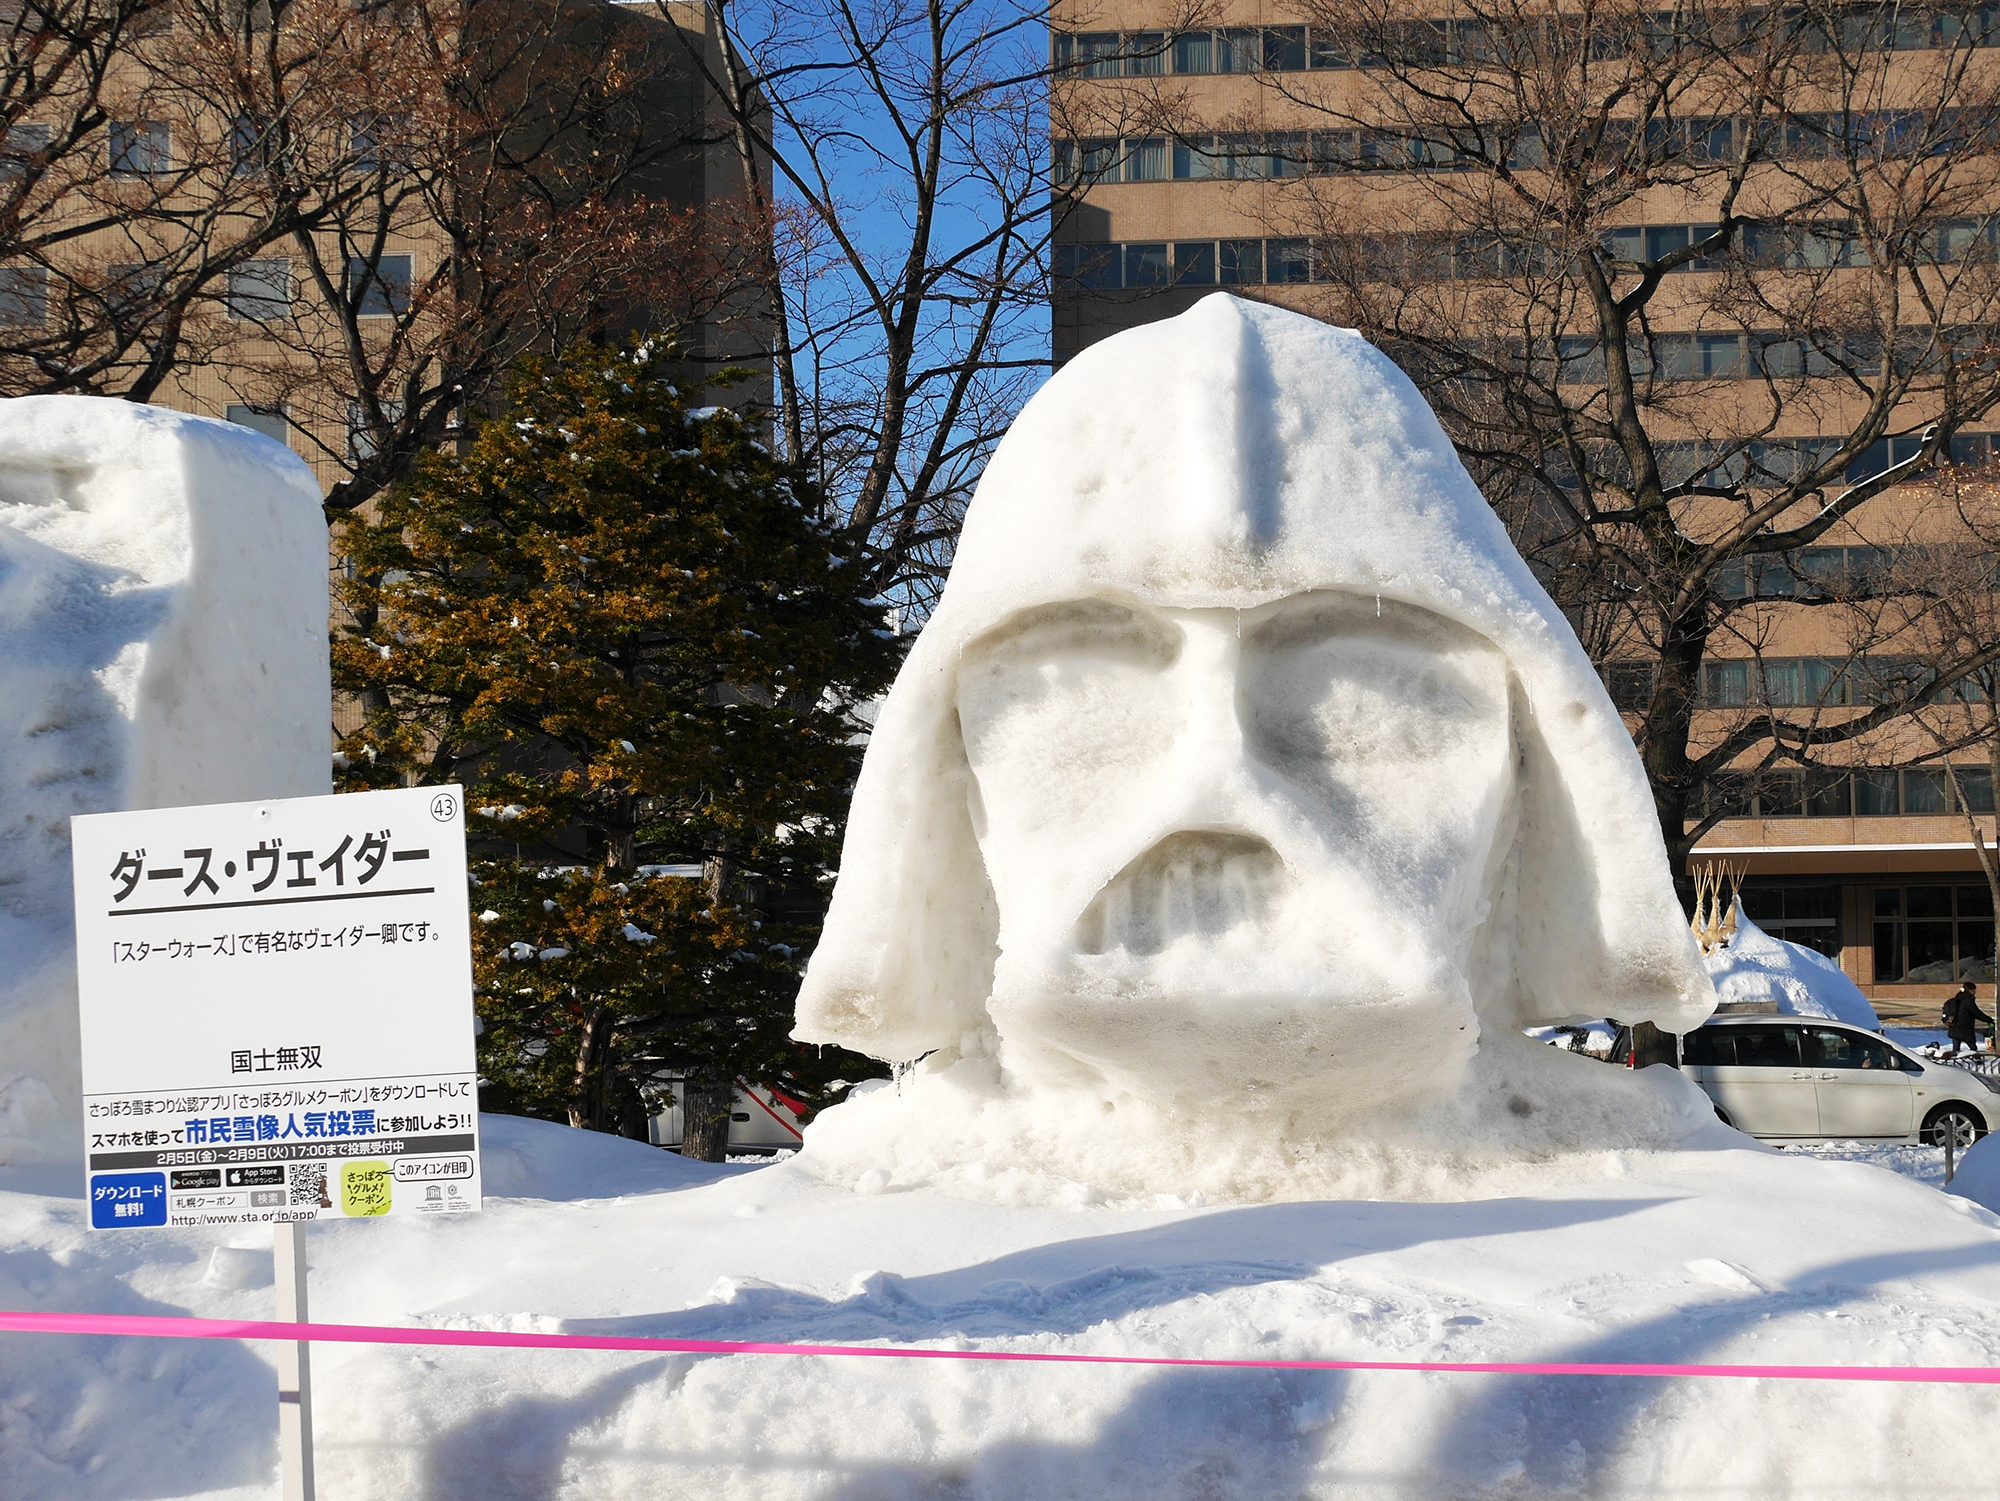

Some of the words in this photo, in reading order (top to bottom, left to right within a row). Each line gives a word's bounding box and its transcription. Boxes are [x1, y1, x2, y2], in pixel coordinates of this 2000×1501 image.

[432, 796, 455, 819] 43
[109, 828, 431, 904] ダース・ヴェイダー
[112, 920, 440, 964] 「スターウォーズ」で有名なヴェイダー卿です。
[230, 1045, 323, 1074] 国士無双
[244, 1169, 259, 1178] App
[399, 1161, 468, 1176] このアイコンが目印
[181, 1177, 206, 1187] Google
[206, 1177, 220, 1186] play
[347, 1170, 384, 1183] さっぽろ
[94, 1184, 163, 1201] ダウンロード
[353, 1183, 379, 1194] グルメ
[176, 1196, 236, 1209] 札幌クーポン
[257, 1193, 279, 1205] 検索
[348, 1194, 384, 1206] クーポン
[114, 1203, 144, 1218] 無料!
